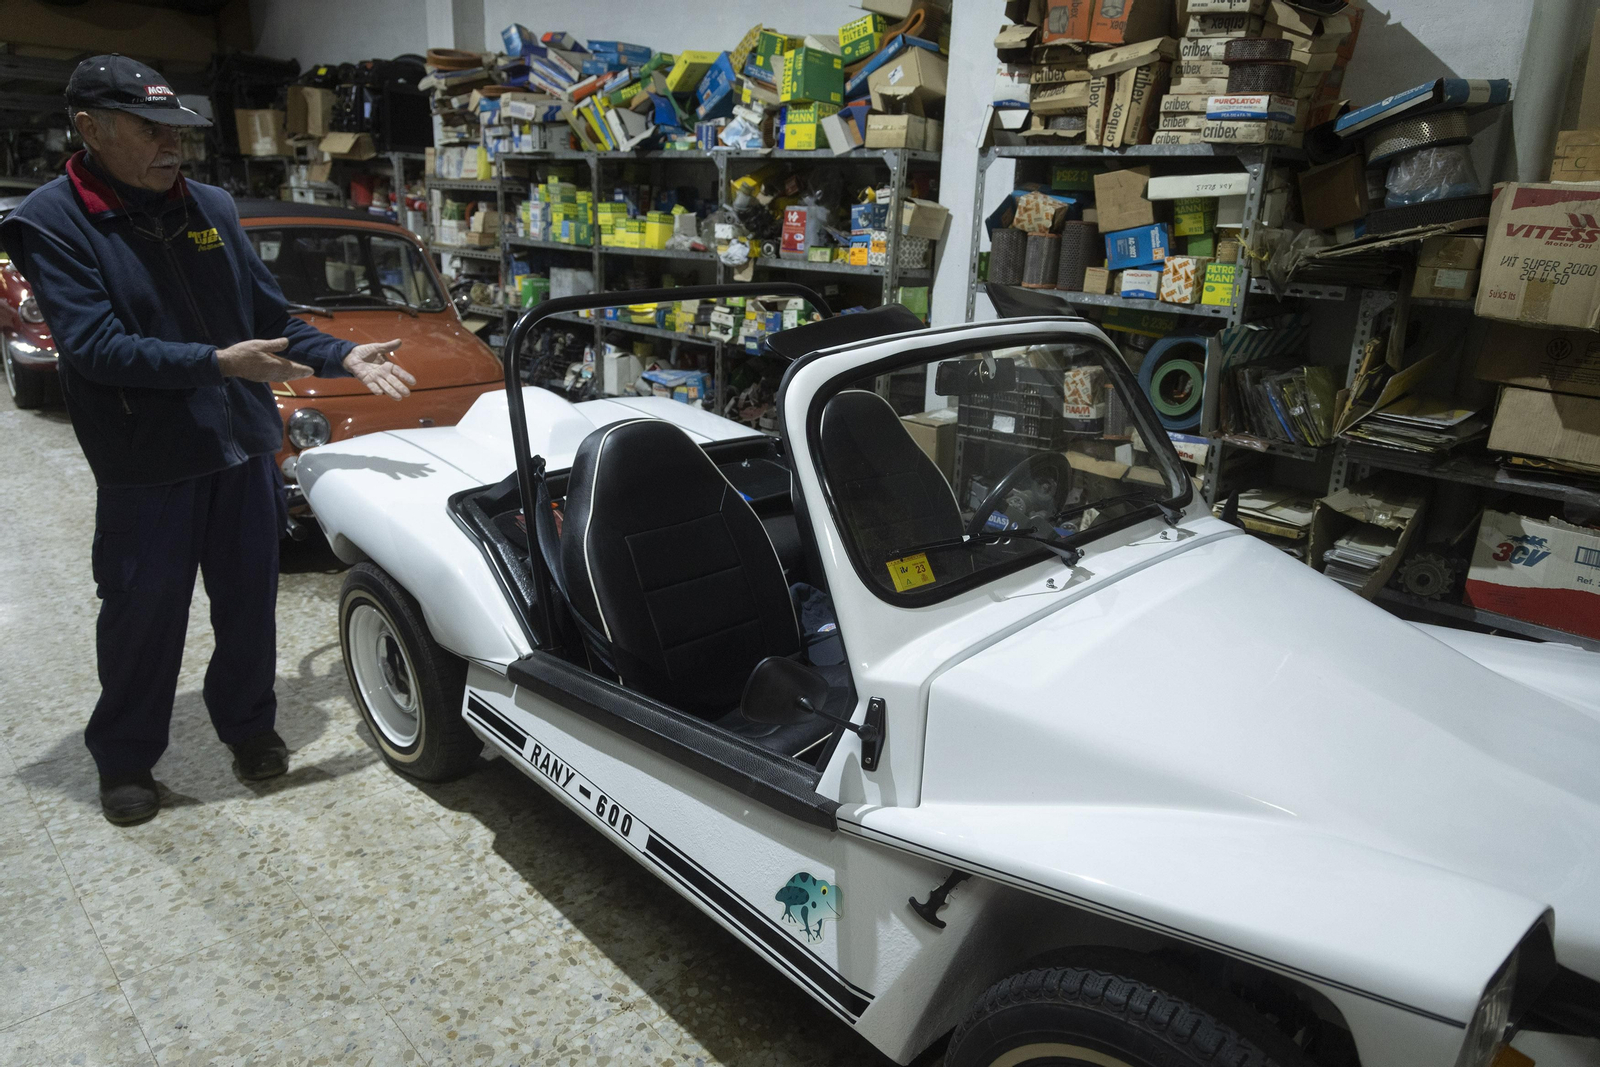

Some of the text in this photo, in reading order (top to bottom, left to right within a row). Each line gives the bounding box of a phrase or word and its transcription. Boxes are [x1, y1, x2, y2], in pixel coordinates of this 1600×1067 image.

[1211, 16, 1245, 35] cribex
[843, 26, 868, 44] FILTER
[1182, 40, 1212, 57] cribex
[1175, 62, 1201, 75] cribex
[1164, 97, 1192, 111] cribex
[1214, 97, 1262, 105] PUROLATOR
[787, 113, 815, 123] MANN
[1106, 103, 1123, 142] cribex
[1162, 116, 1187, 128] cribex
[1202, 122, 1239, 139] cribex
[1155, 131, 1181, 144] cribex
[1056, 170, 1088, 181] C 2354
[1544, 240, 1574, 248] Motor
[1521, 257, 1561, 273] SUPER
[1563, 262, 1598, 276] 2000
[1519, 269, 1537, 281] 20
[1492, 542, 1552, 567] 3CV
[915, 564, 926, 574] 23
[1577, 575, 1595, 586] Ref.
[530, 743, 576, 788] RANY
[595, 794, 633, 837] 600
